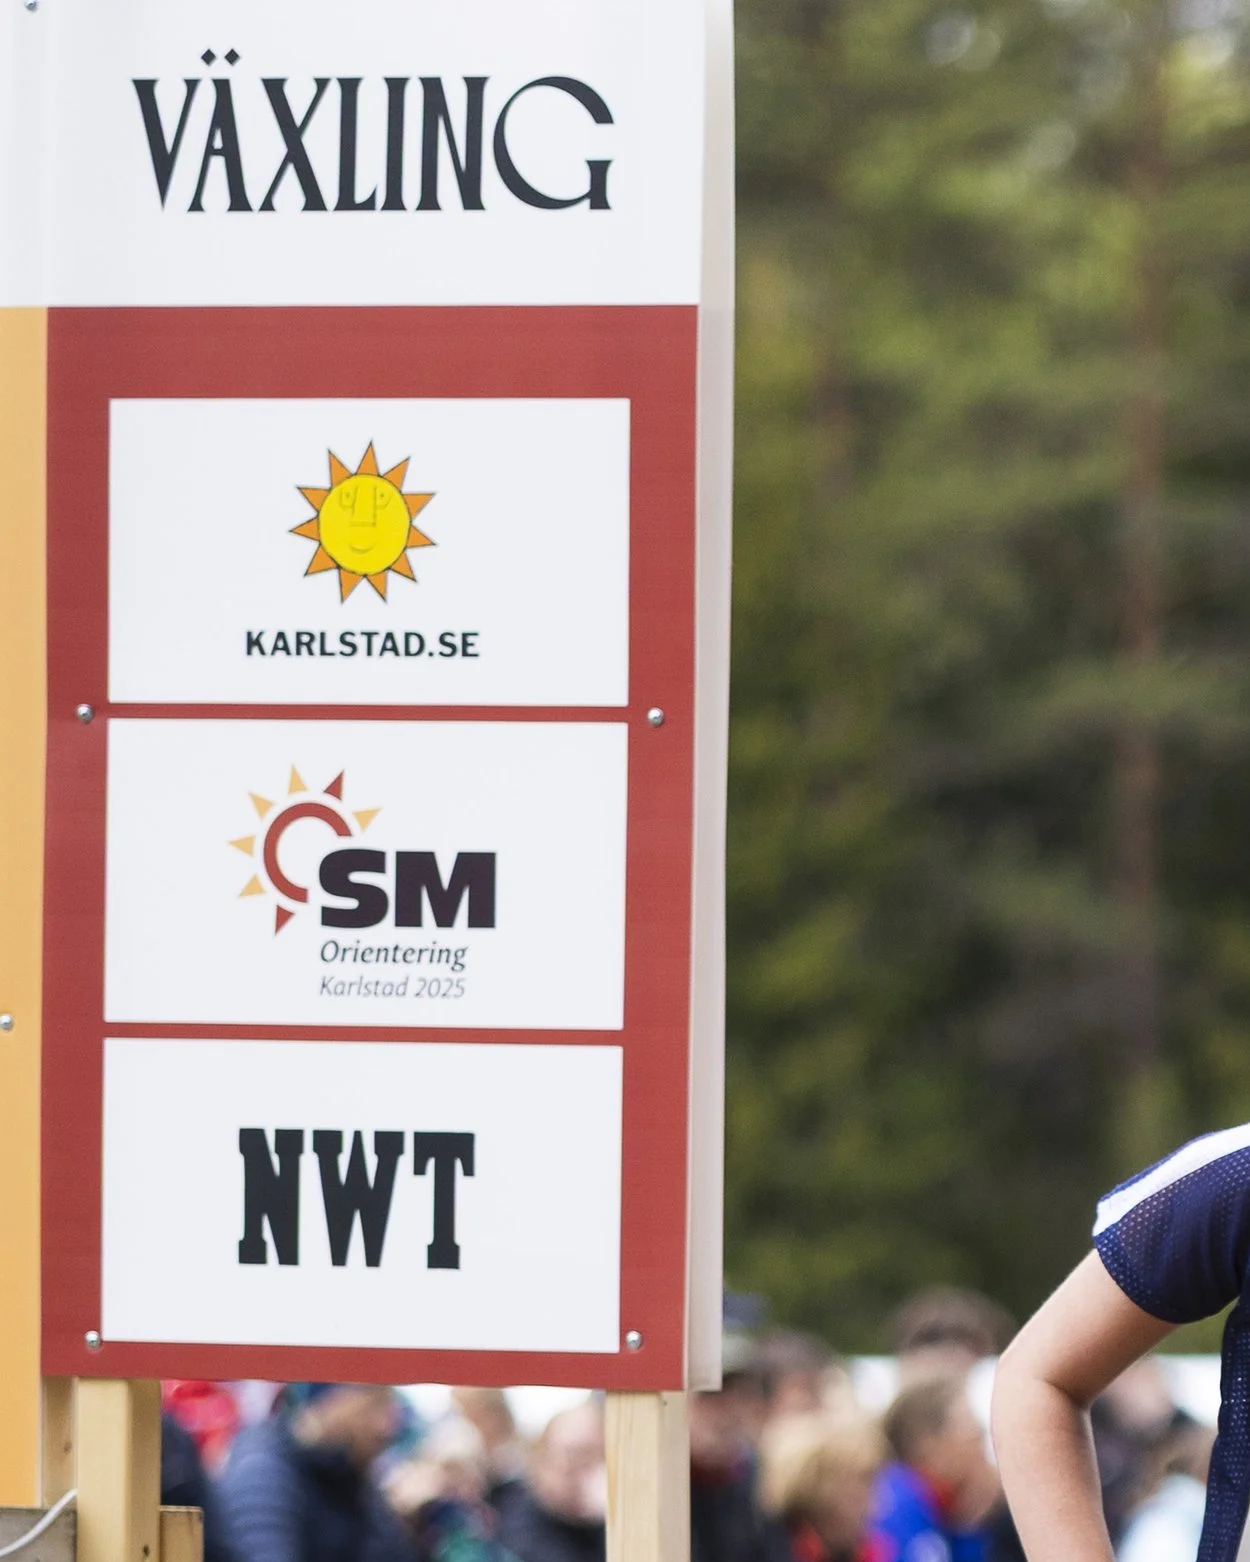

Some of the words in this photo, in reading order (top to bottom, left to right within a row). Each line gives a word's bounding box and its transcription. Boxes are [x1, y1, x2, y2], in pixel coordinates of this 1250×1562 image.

[132, 48, 614, 213] VÄXLING
[246, 631, 480, 658] KARLSTAD.SE
[319, 848, 496, 929] SM
[320, 940, 469, 972] Orientering
[319, 975, 410, 998] Karlstad
[414, 977, 466, 998] 2025
[238, 1127, 476, 1270] NWT
